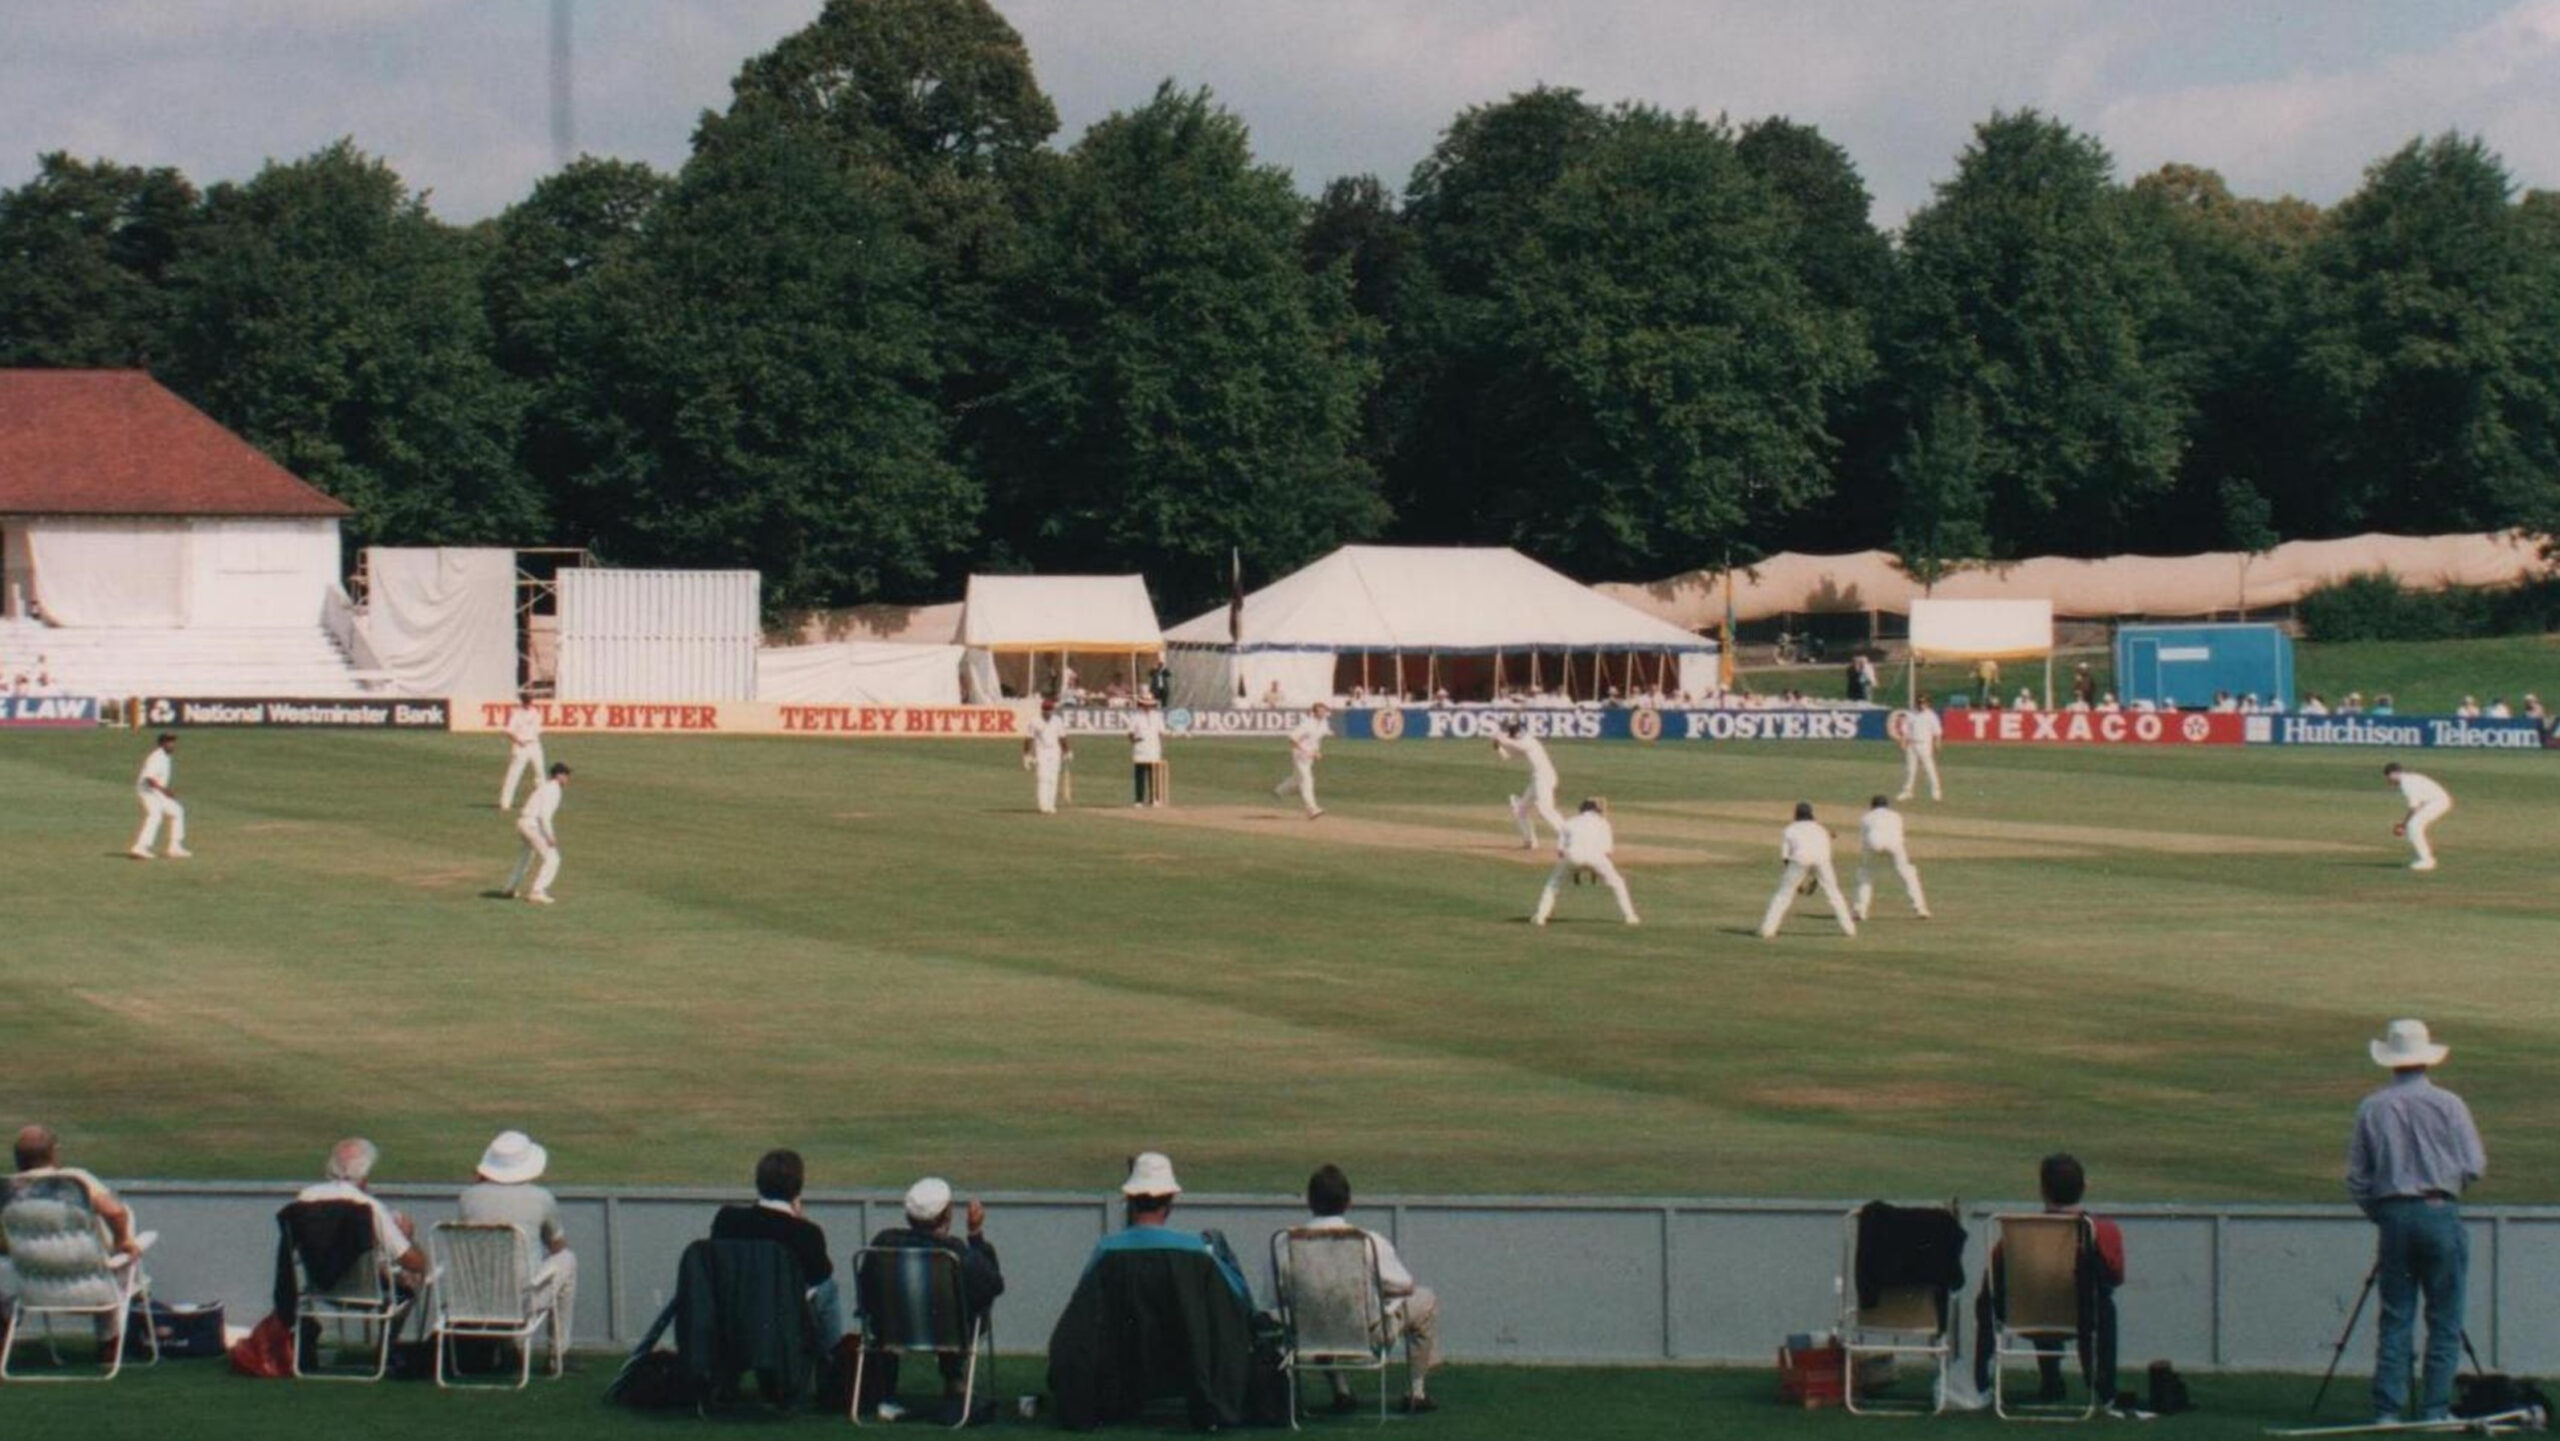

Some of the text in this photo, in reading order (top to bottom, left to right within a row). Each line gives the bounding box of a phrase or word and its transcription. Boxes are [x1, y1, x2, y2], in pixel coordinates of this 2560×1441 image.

[15, 699, 88, 718] LAW
[184, 703, 443, 723] National Westminster Bank
[481, 703, 717, 729] TLEY BITTER
[781, 706, 1017, 733] TETLEY BITTER
[1062, 709, 1300, 730] FRIEN PROVIDE
[1685, 711, 1862, 739] FOSTER'S
[1968, 713, 2162, 740] TEXACO
[2282, 717, 2421, 745] Hutchison
[2429, 719, 2541, 747] Telecom
